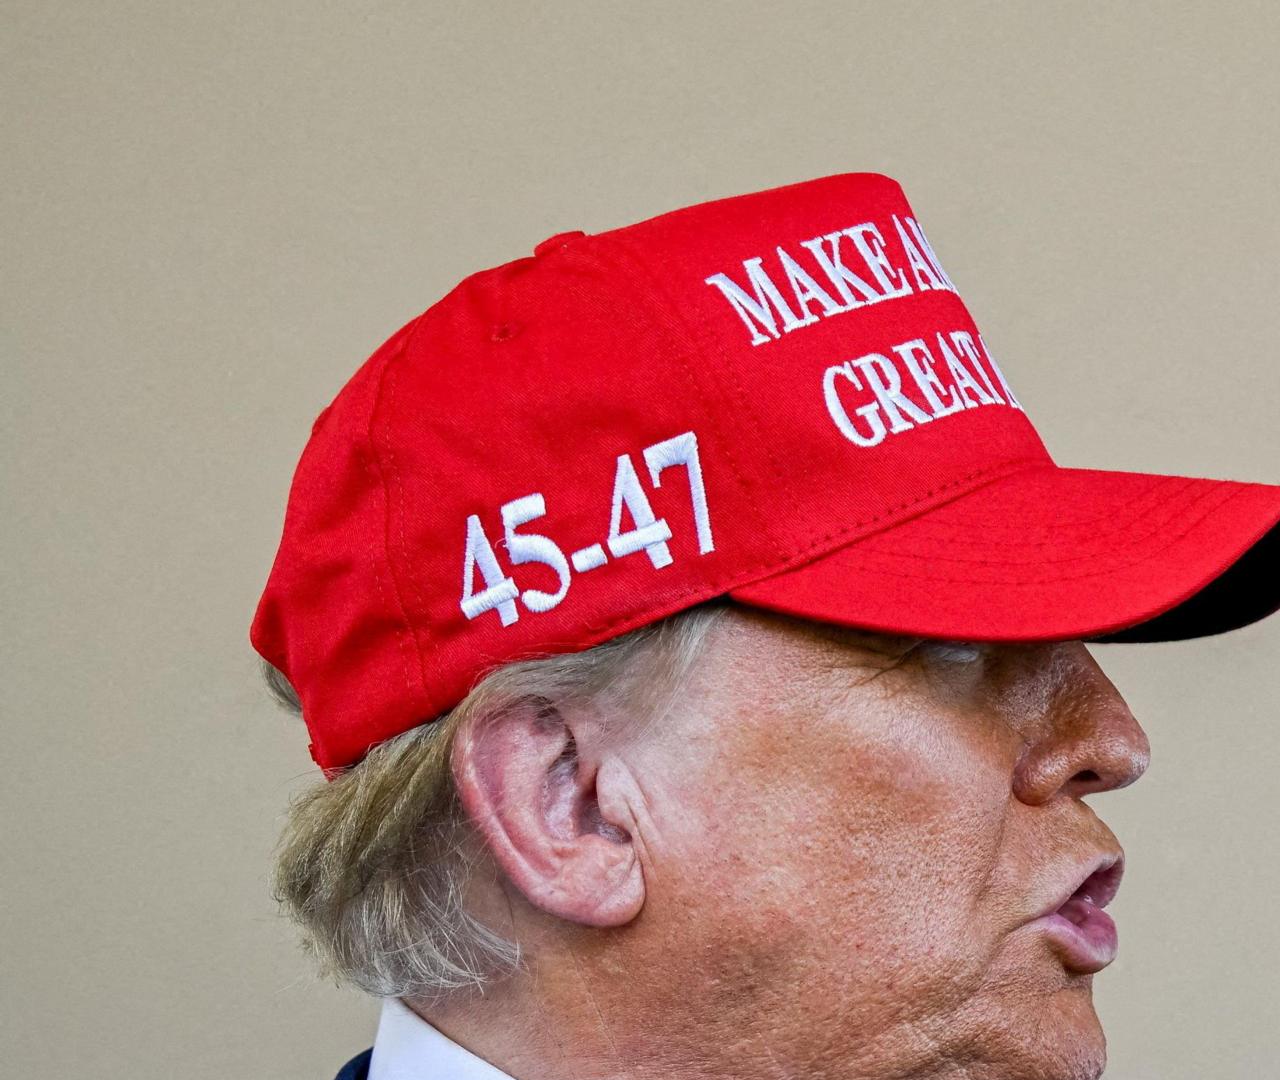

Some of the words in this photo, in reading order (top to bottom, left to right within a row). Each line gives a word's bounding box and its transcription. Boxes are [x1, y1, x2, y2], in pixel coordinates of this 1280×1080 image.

[704, 222, 913, 347] MAKE
[822, 331, 1006, 448] GREAT
[460, 431, 716, 628] 45-47
